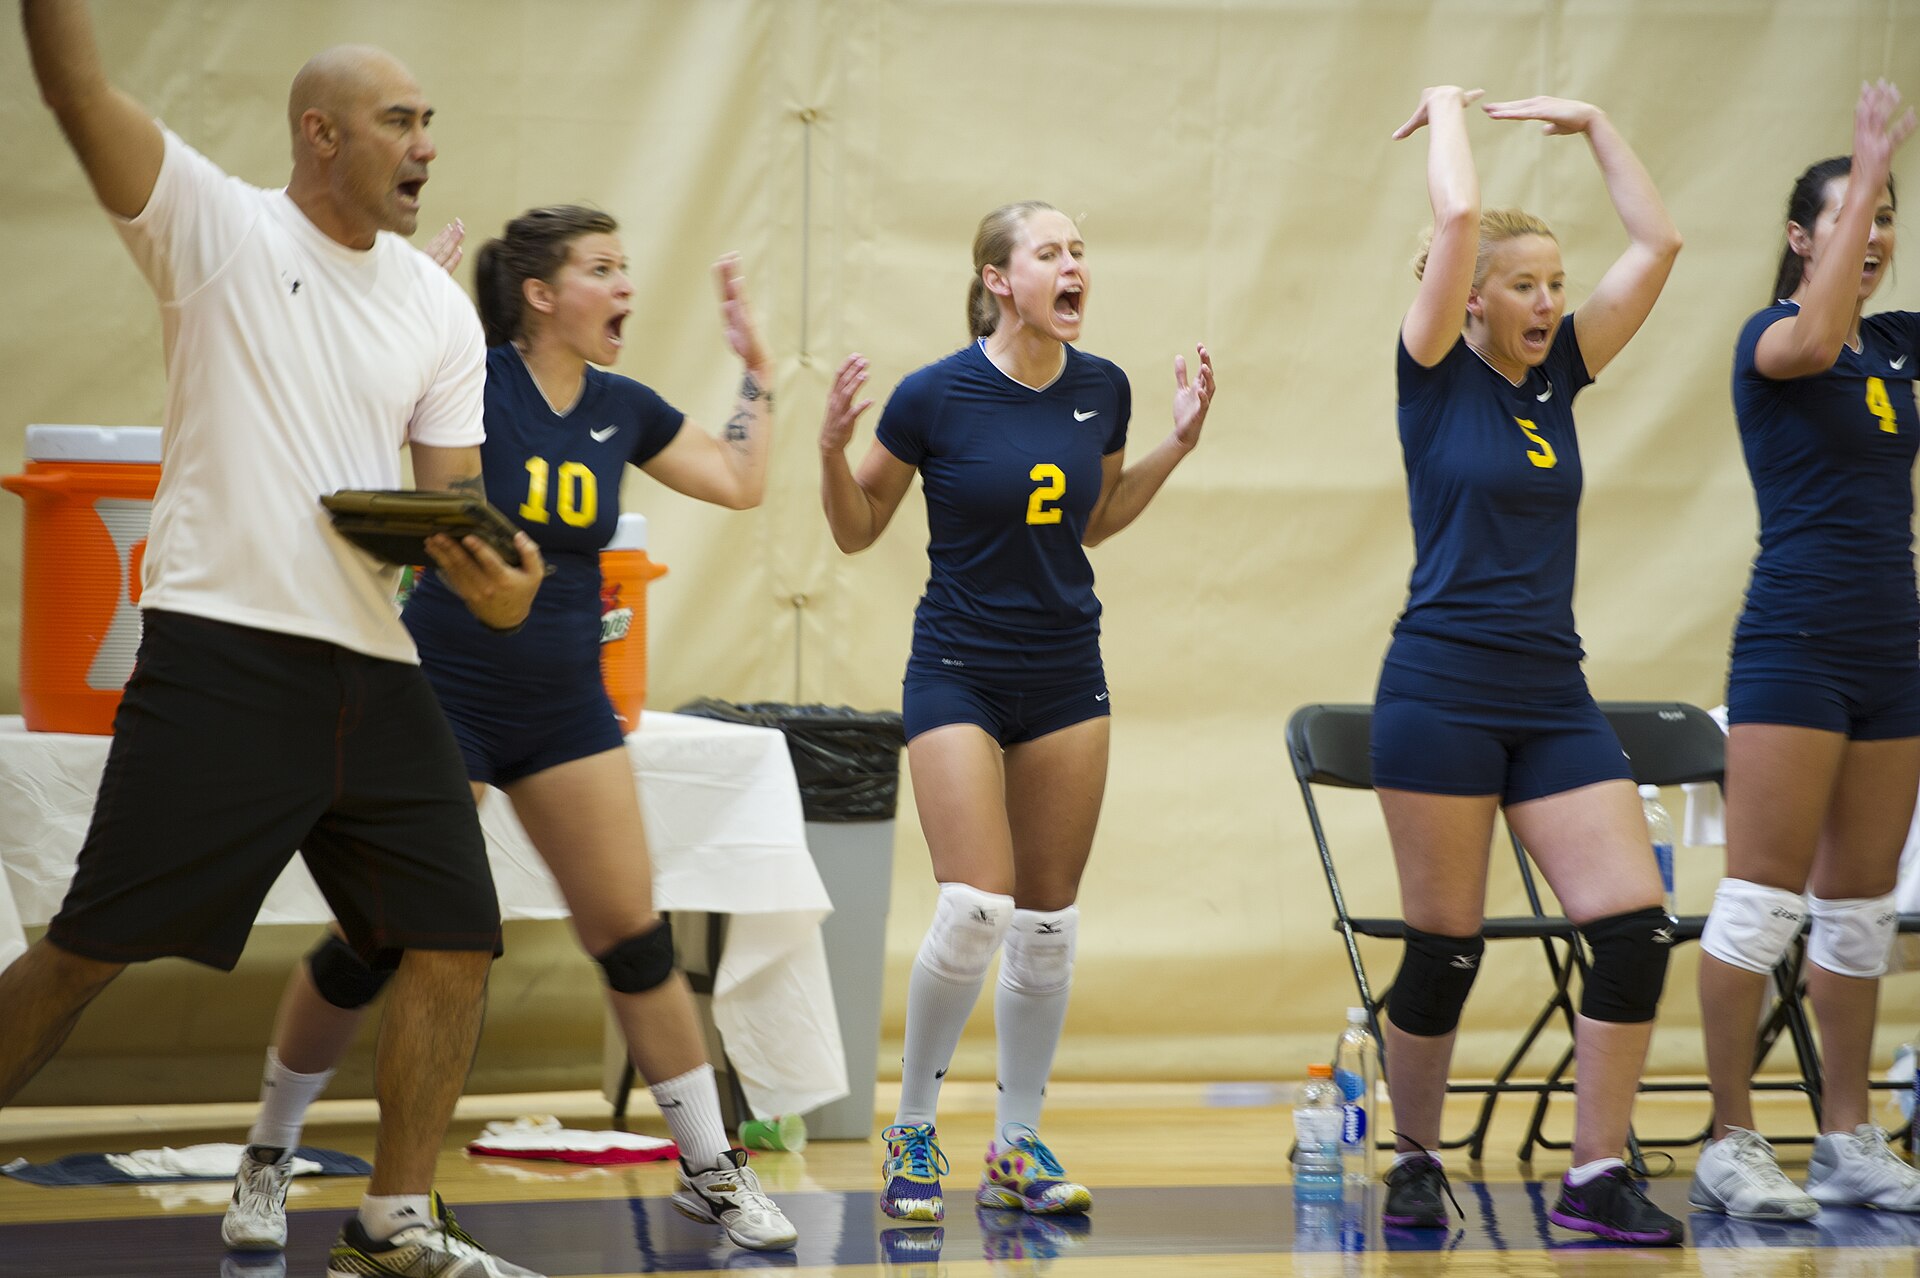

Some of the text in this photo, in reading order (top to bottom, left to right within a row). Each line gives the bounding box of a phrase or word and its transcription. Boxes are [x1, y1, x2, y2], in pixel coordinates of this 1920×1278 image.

[1865, 376, 1899, 434] 4
[1512, 415, 1558, 469] 5
[519, 455, 598, 529] 10
[1025, 463, 1066, 526] 2
